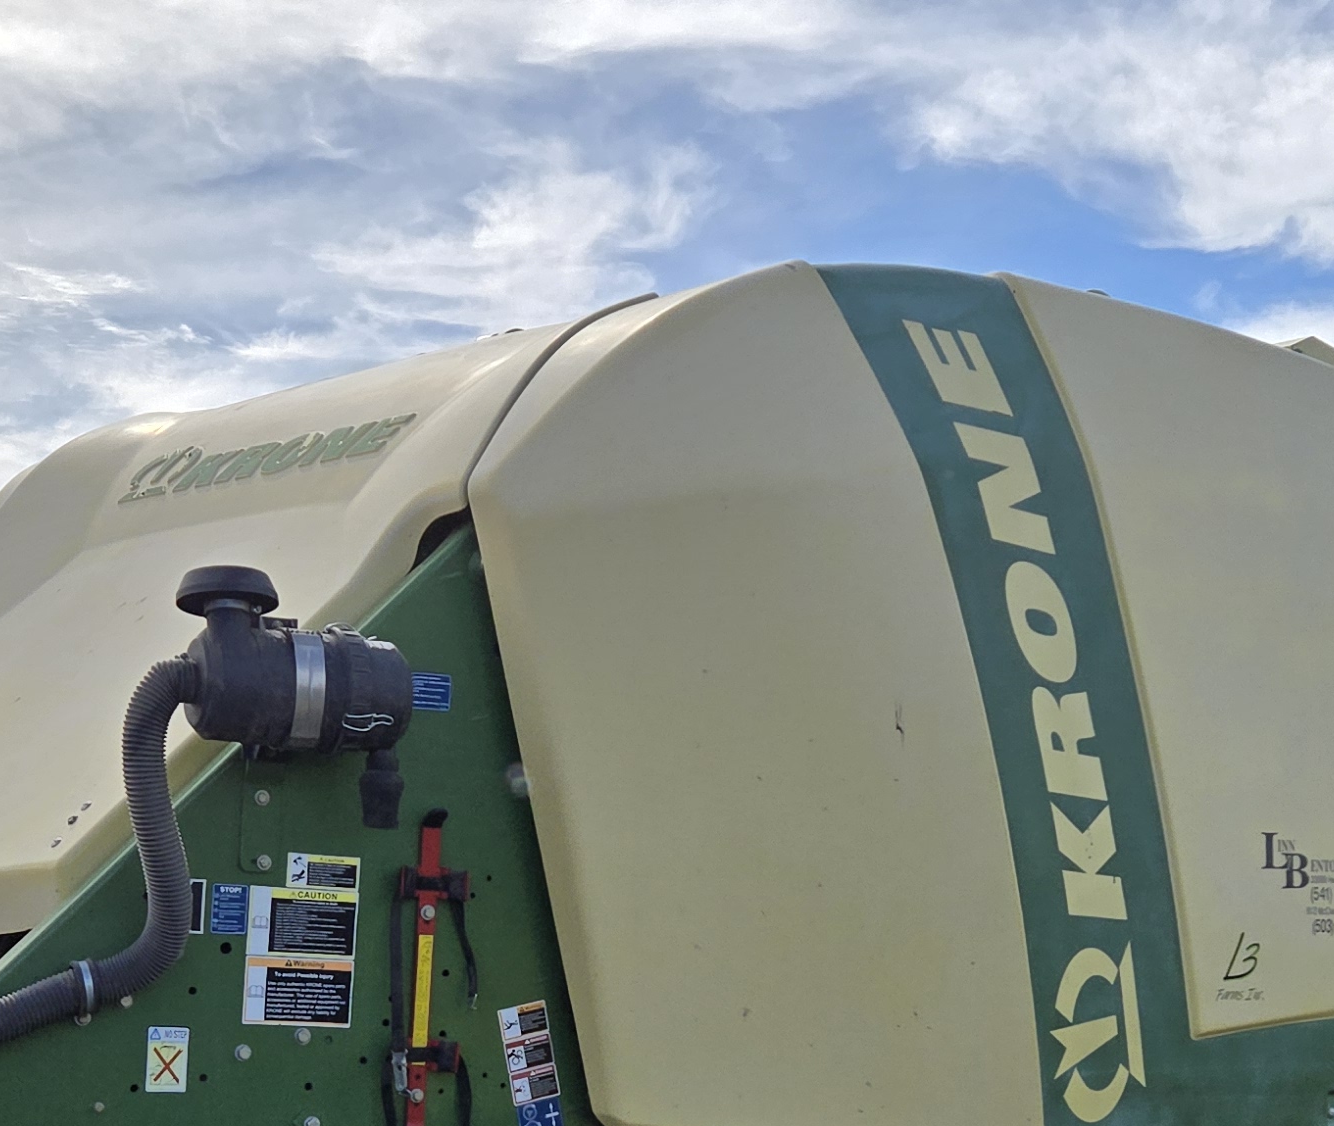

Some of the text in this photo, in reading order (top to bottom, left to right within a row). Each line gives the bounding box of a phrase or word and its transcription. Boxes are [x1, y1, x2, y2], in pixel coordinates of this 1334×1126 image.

[172, 412, 417, 493] KRONE
[901, 320, 1128, 920] KRONE
[219, 886, 242, 894] STOP!
[297, 891, 338, 900] CAUTION
[1311, 887, 1332, 904] (541)
[1312, 918, 1334, 935] (503)
[293, 960, 325, 968] Warning
[173, 1030, 187, 1039] STEP
